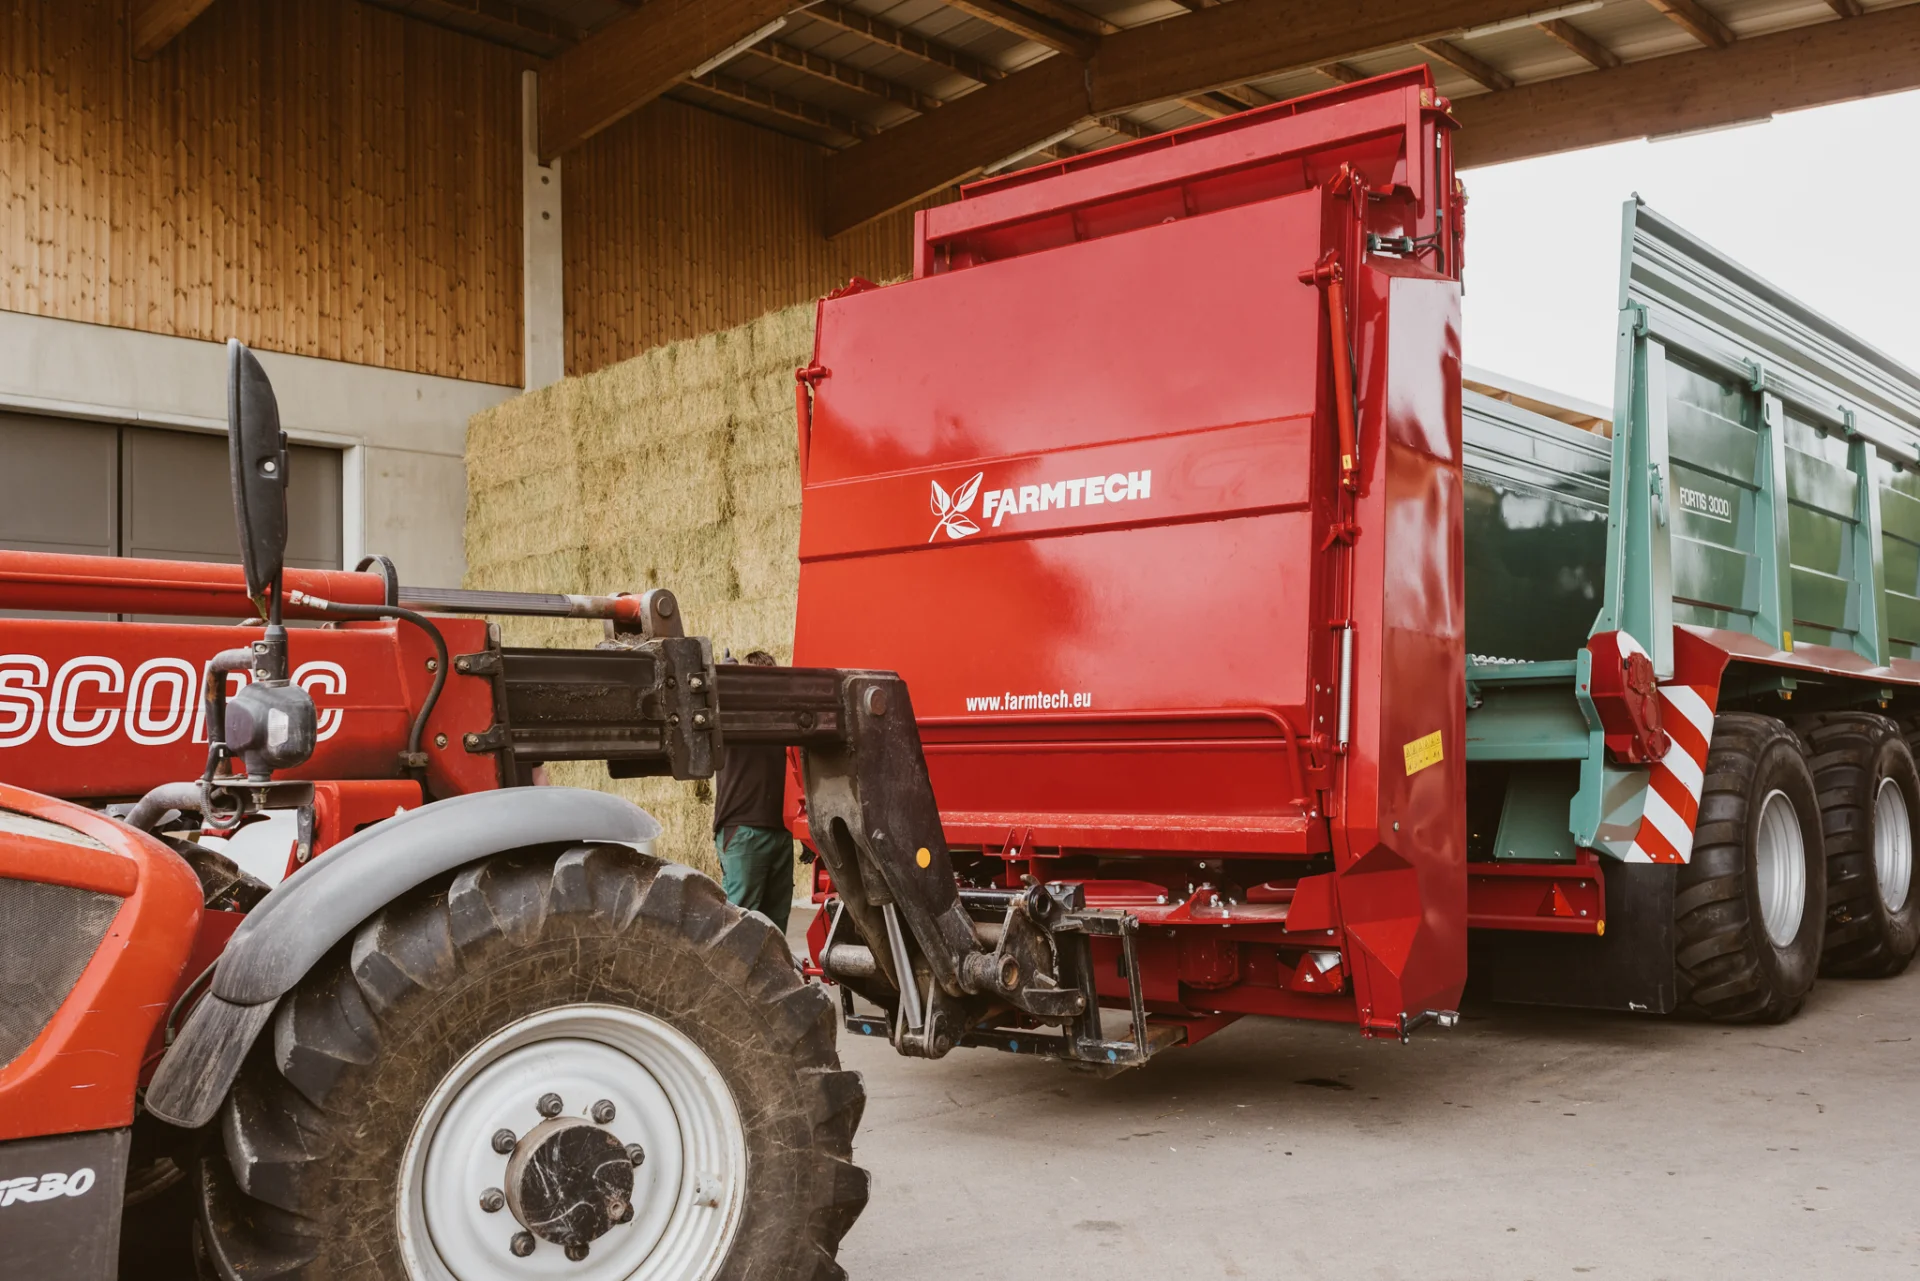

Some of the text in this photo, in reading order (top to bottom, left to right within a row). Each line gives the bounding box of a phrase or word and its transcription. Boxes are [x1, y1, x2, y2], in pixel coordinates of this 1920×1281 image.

[982, 469, 1152, 528] FARMTECH
[1679, 486, 1730, 517] FORTIS 3000
[965, 689, 1092, 712] www.farmtech.eu
[0, 1167, 96, 1208] RBO
